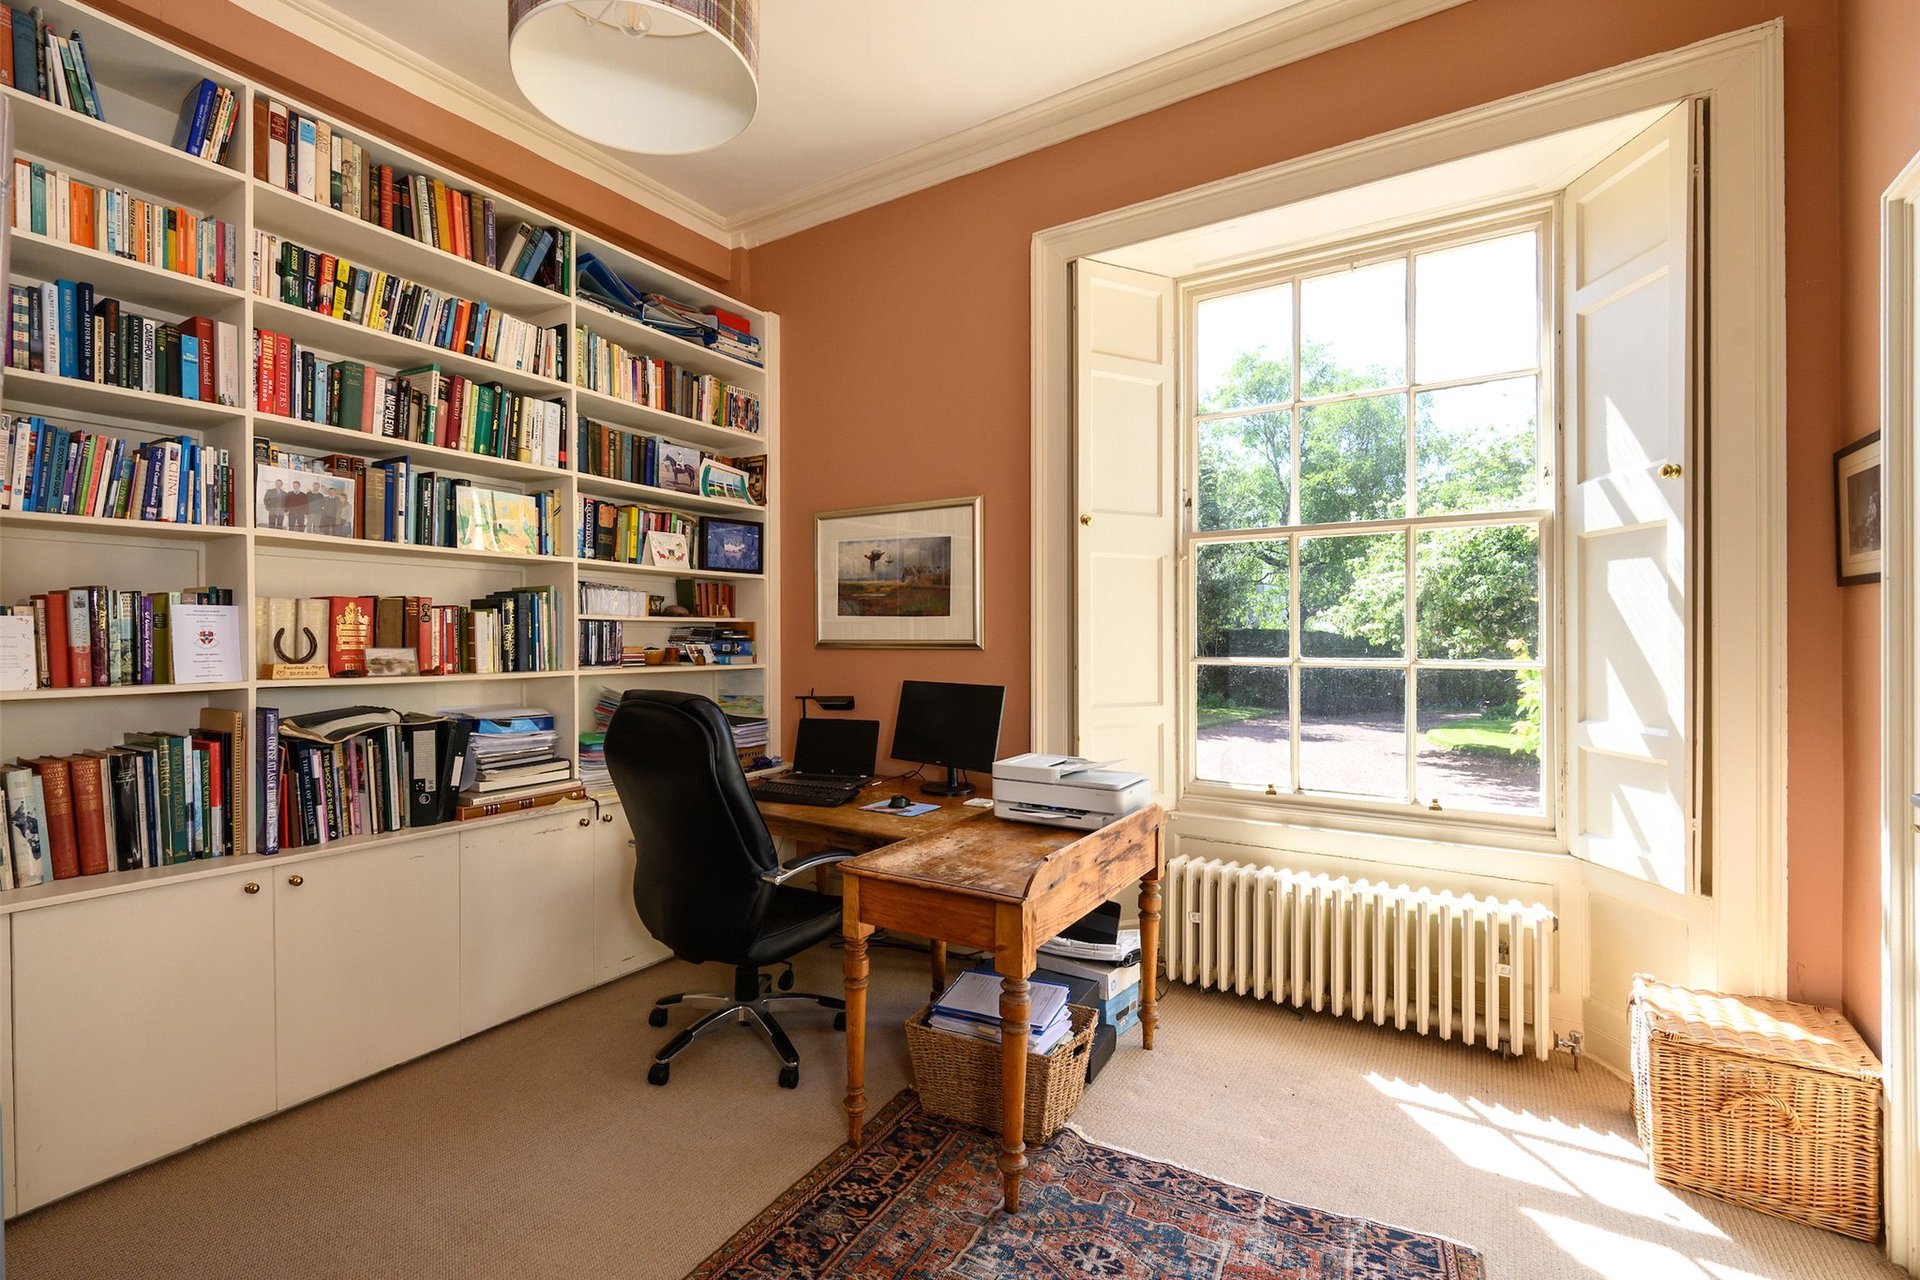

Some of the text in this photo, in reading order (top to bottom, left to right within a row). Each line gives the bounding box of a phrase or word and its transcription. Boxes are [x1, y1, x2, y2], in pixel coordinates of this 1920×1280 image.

[144, 323, 153, 361] CAMERON
[262, 335, 273, 370] SOLDIERS
[202, 339, 211, 385] Lord Mansfield
[279, 342, 288, 408] GREAT LETTERS
[385, 394, 396, 435] NAPOLEON
[57, 447, 65, 462] GOOD
[53, 481, 61, 498] GUIDE
[167, 462, 178, 497] CHINA
[150, 486, 159, 506] Australia
[585, 503, 594, 548] QUOTATIONS
[160, 744, 171, 797] EL GRECO
[174, 774, 182, 788] ART
[305, 790, 311, 800] OF
[325, 788, 332, 799] OF
[306, 800, 315, 825] TITIAN
[327, 812, 335, 826] NEW
